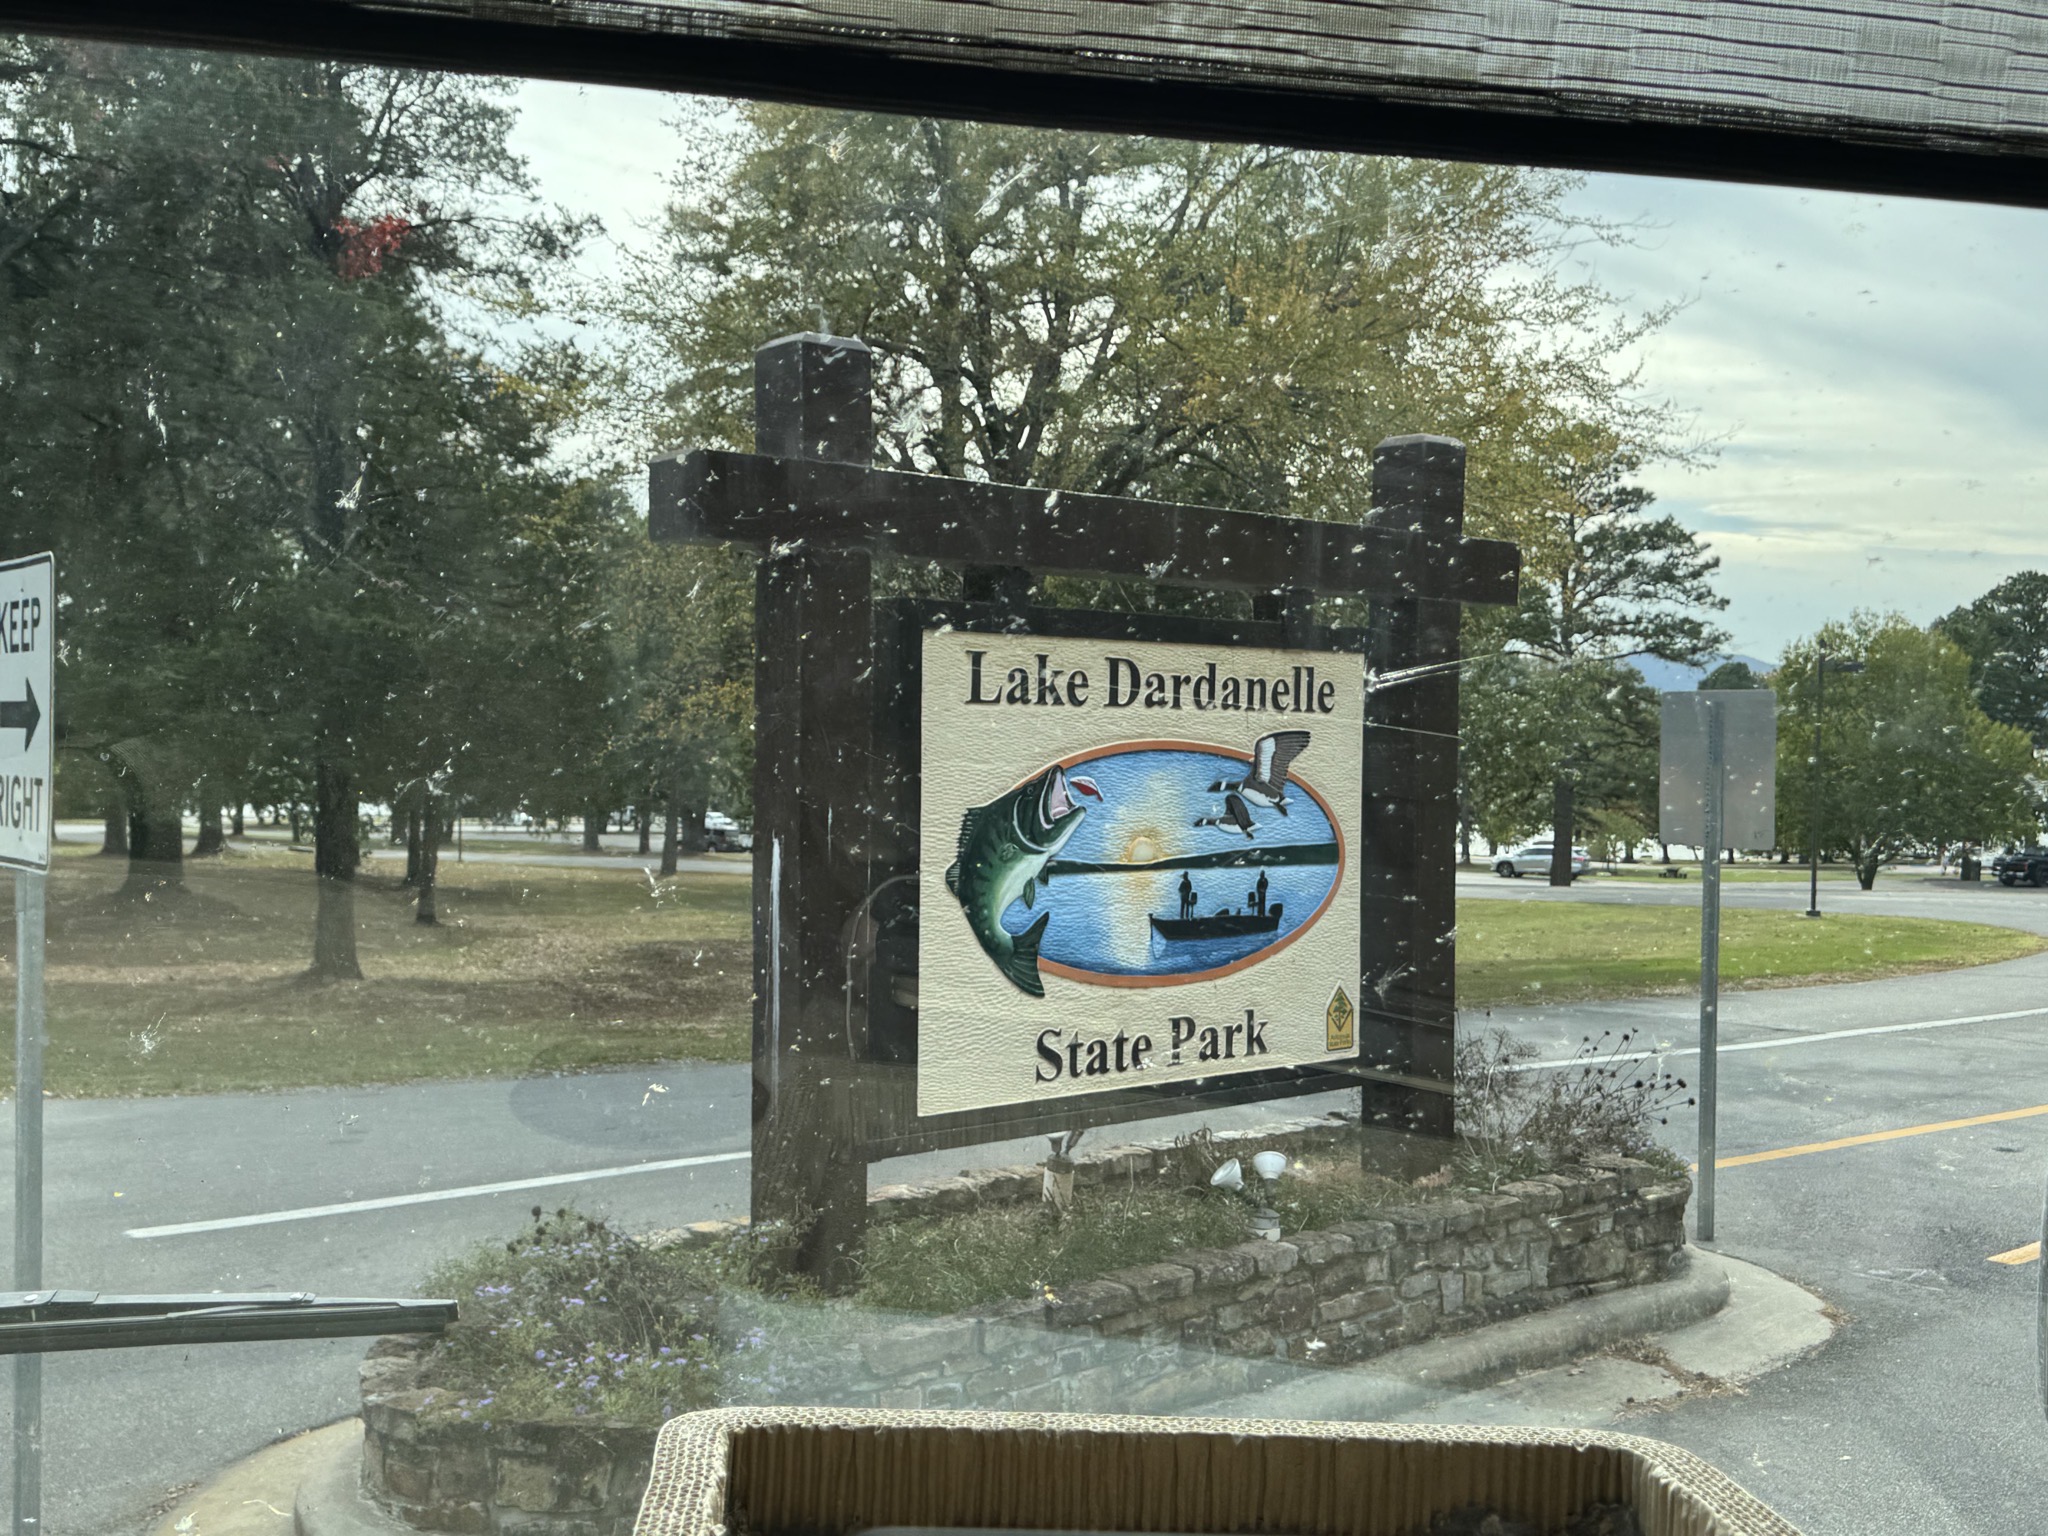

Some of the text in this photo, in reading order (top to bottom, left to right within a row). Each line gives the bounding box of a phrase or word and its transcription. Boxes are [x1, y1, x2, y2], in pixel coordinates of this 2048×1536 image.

[0, 597, 41, 653] KEEP
[964, 650, 1335, 714] Lake Dardanelle
[1035, 1008, 1269, 1083] State Park
